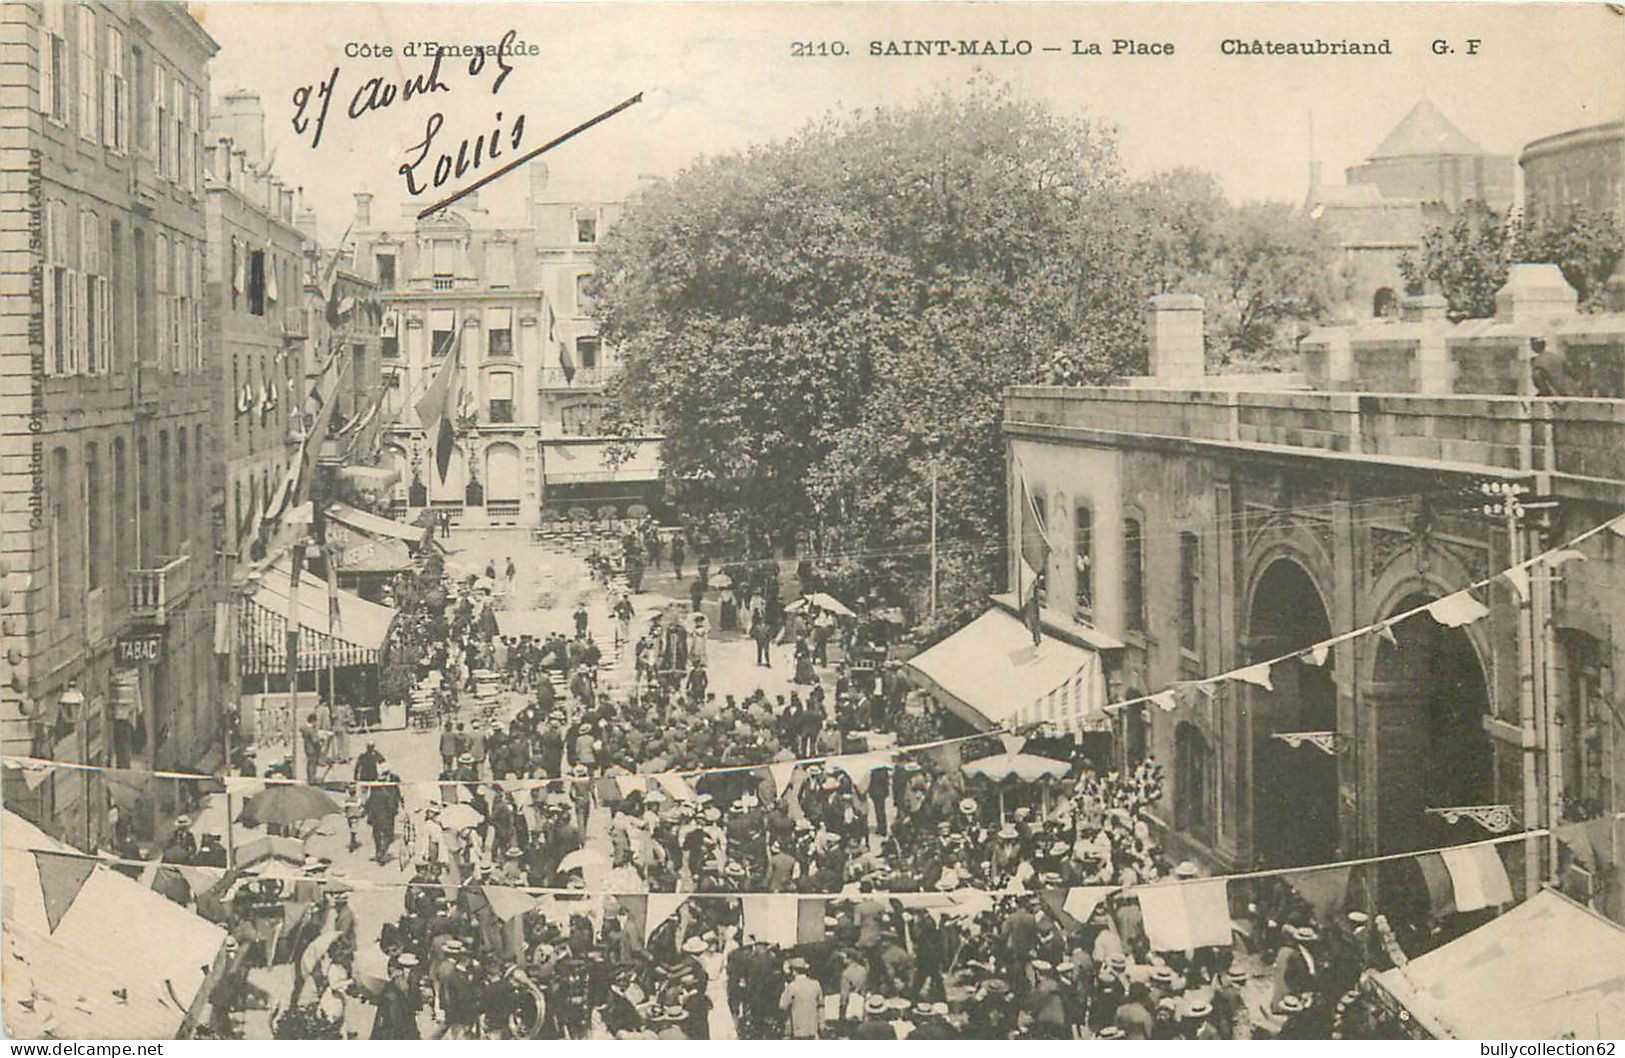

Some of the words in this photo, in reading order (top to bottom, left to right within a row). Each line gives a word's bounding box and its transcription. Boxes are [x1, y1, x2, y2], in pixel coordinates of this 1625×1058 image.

[292, 67, 339, 149] 27
[398, 112, 526, 195] Louis
[121, 641, 158, 660] TABAC
